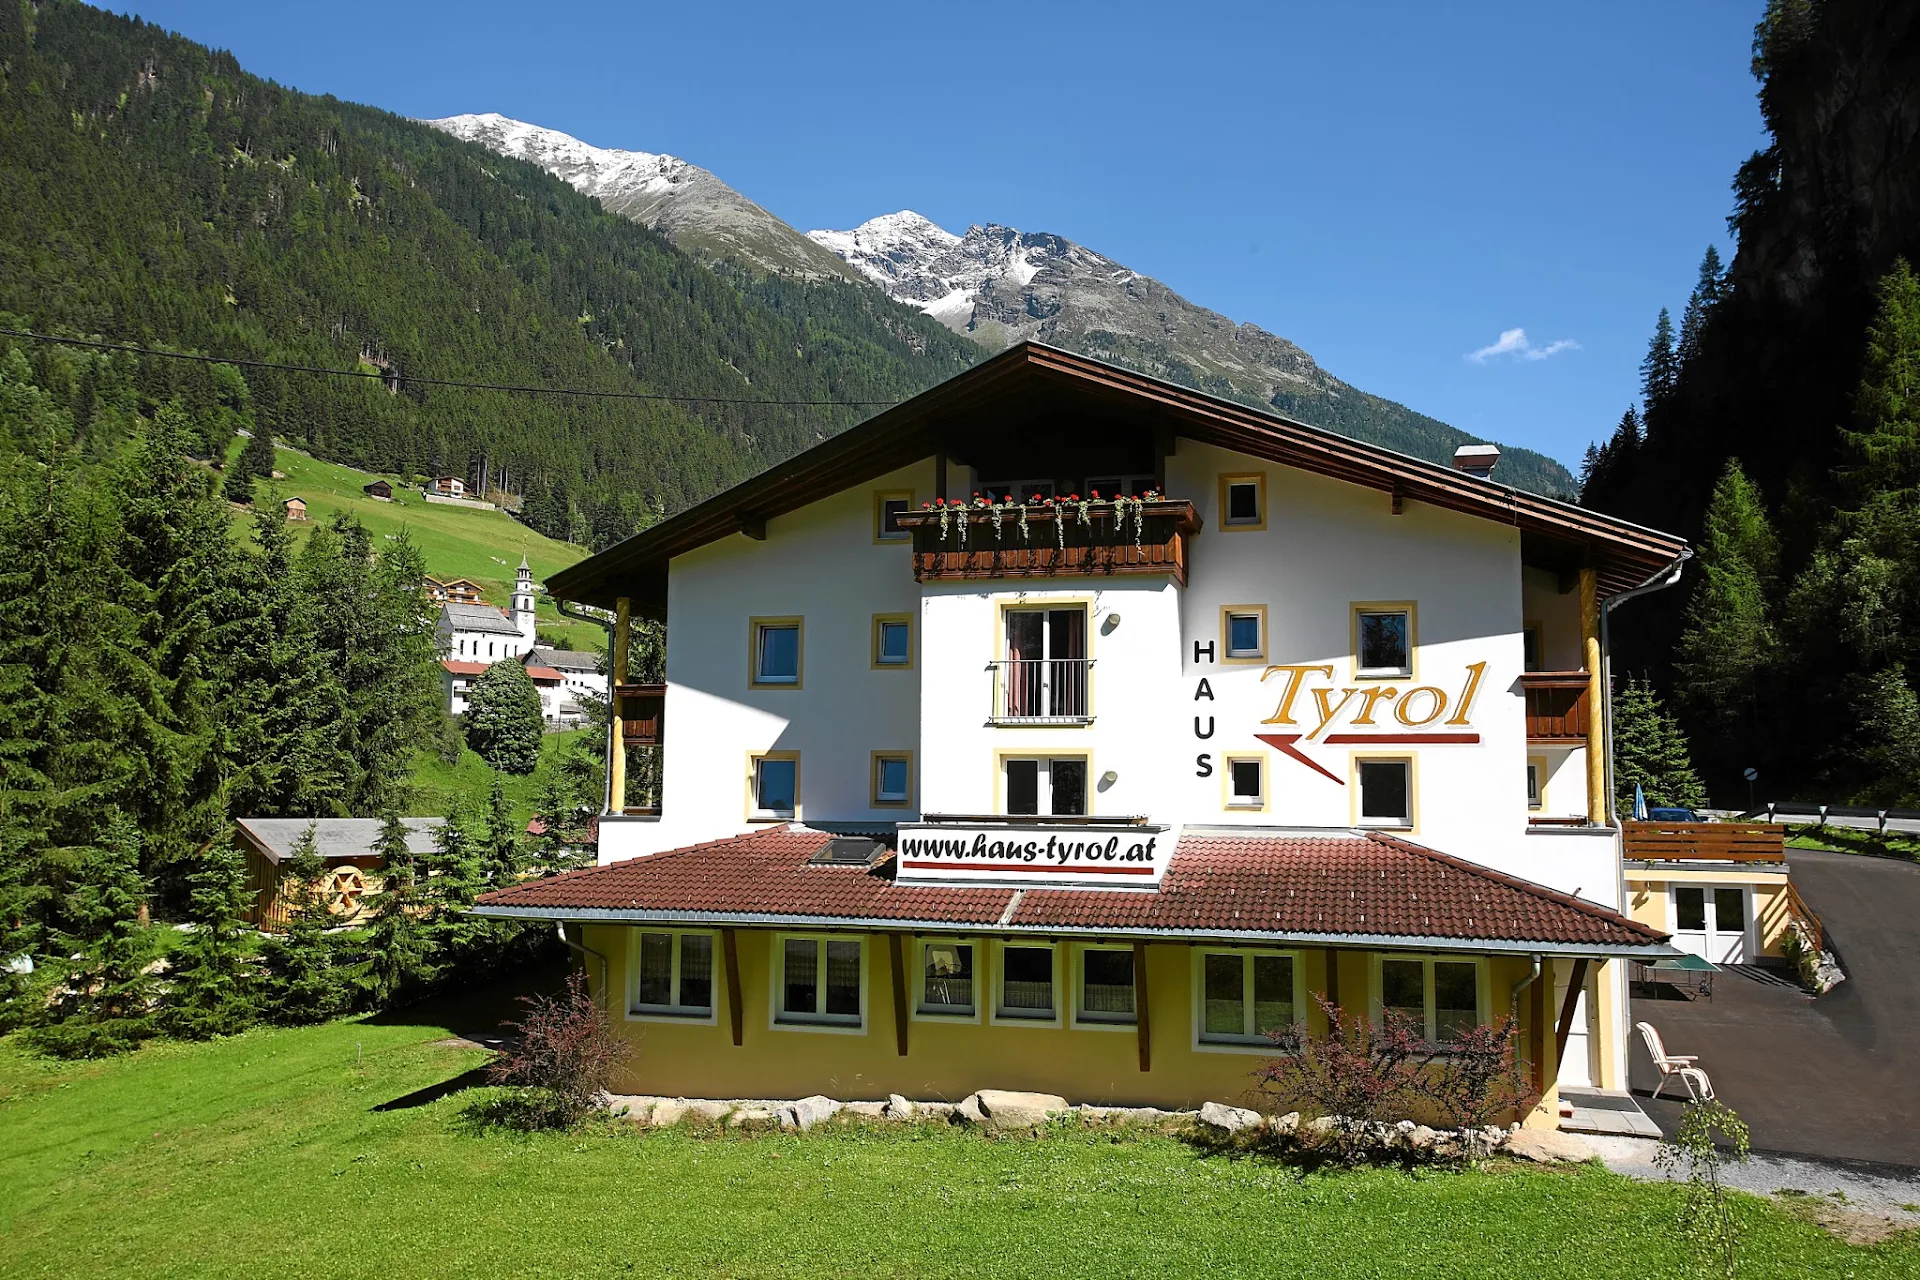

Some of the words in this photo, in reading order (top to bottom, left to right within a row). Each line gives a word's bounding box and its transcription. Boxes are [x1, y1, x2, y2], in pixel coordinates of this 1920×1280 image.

[1194, 640, 1215, 778] HAUS
[1261, 660, 1488, 741] Tyrol
[901, 833, 1157, 865] www.haus-tyrol.at
